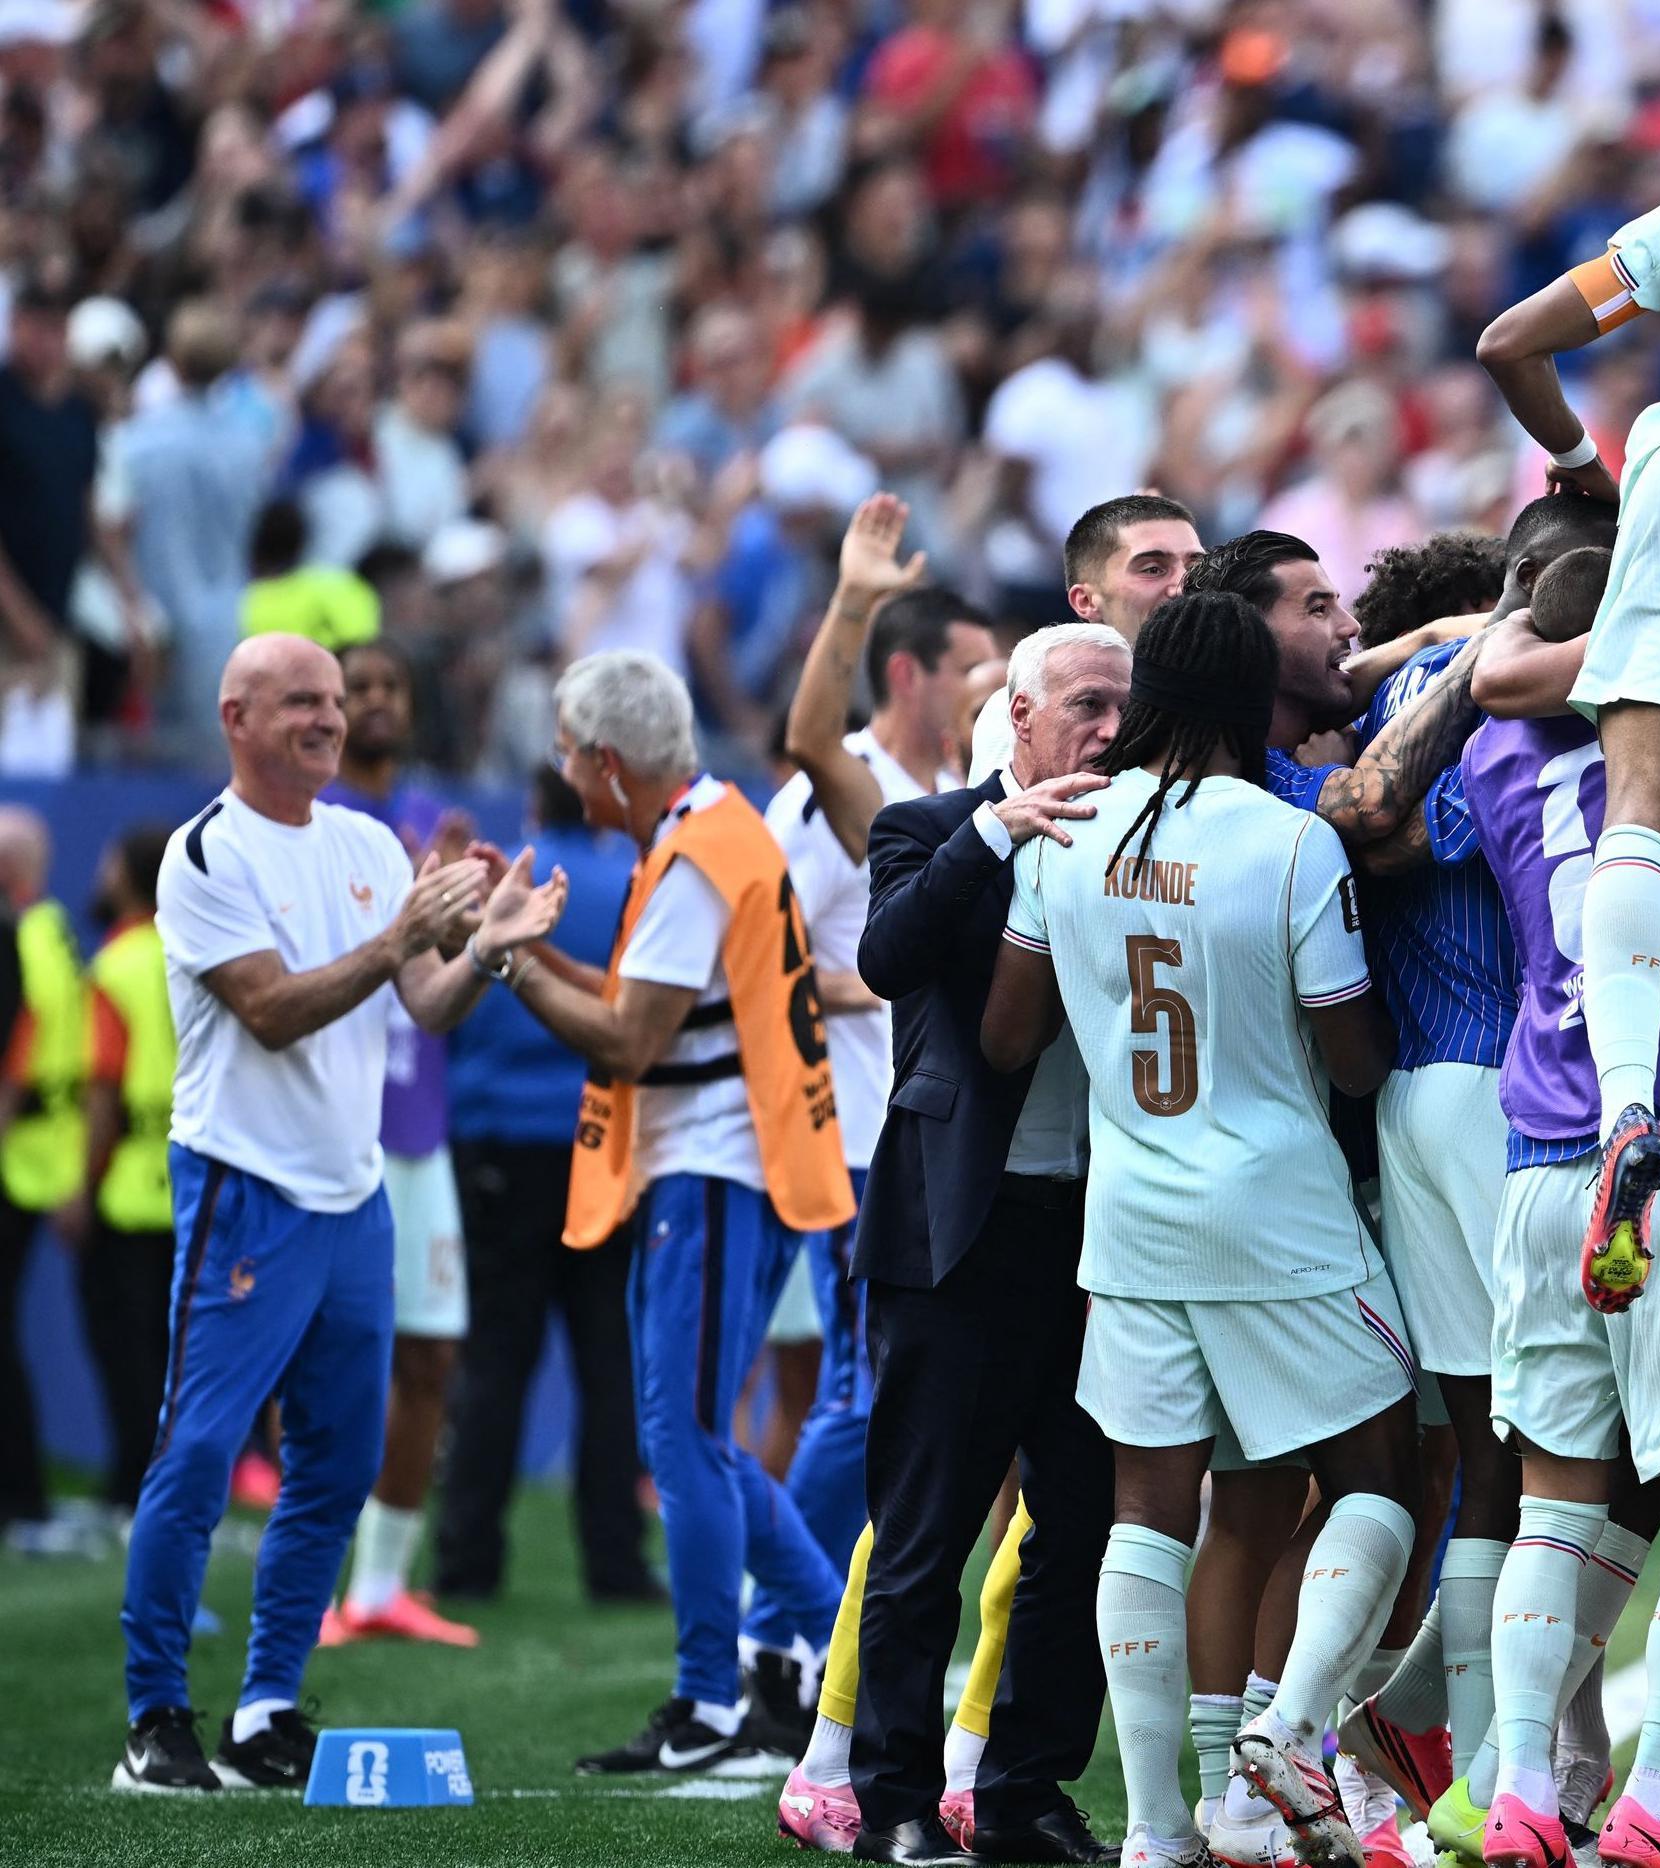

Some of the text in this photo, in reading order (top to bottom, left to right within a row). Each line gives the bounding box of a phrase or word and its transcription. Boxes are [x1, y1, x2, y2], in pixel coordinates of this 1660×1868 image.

[1103, 854, 1199, 906] KOUNDE
[1124, 935, 1199, 1117] 5
[1503, 1613, 1562, 1625] FFF
[1109, 1640, 1160, 1659] FFF
[1443, 1664, 1468, 1677] FF
